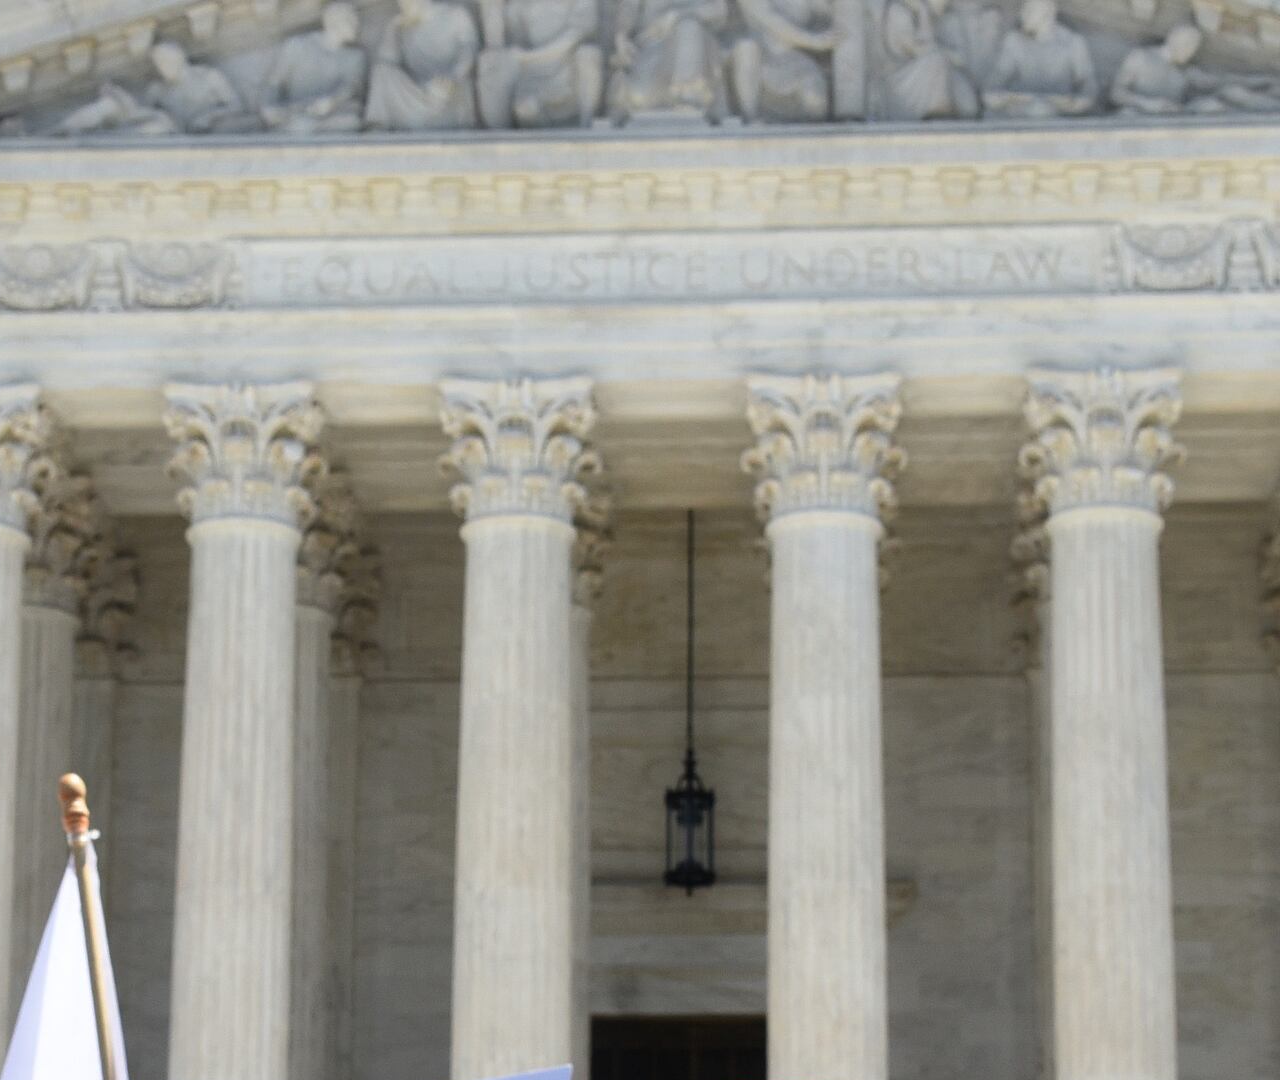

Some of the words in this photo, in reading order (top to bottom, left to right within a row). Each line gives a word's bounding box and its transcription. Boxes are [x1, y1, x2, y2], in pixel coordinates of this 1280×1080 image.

[281, 256, 466, 297] EQUAL
[486, 250, 708, 295] JUSTICE
[739, 246, 936, 291] UNDER
[952, 245, 1063, 287] LAW
